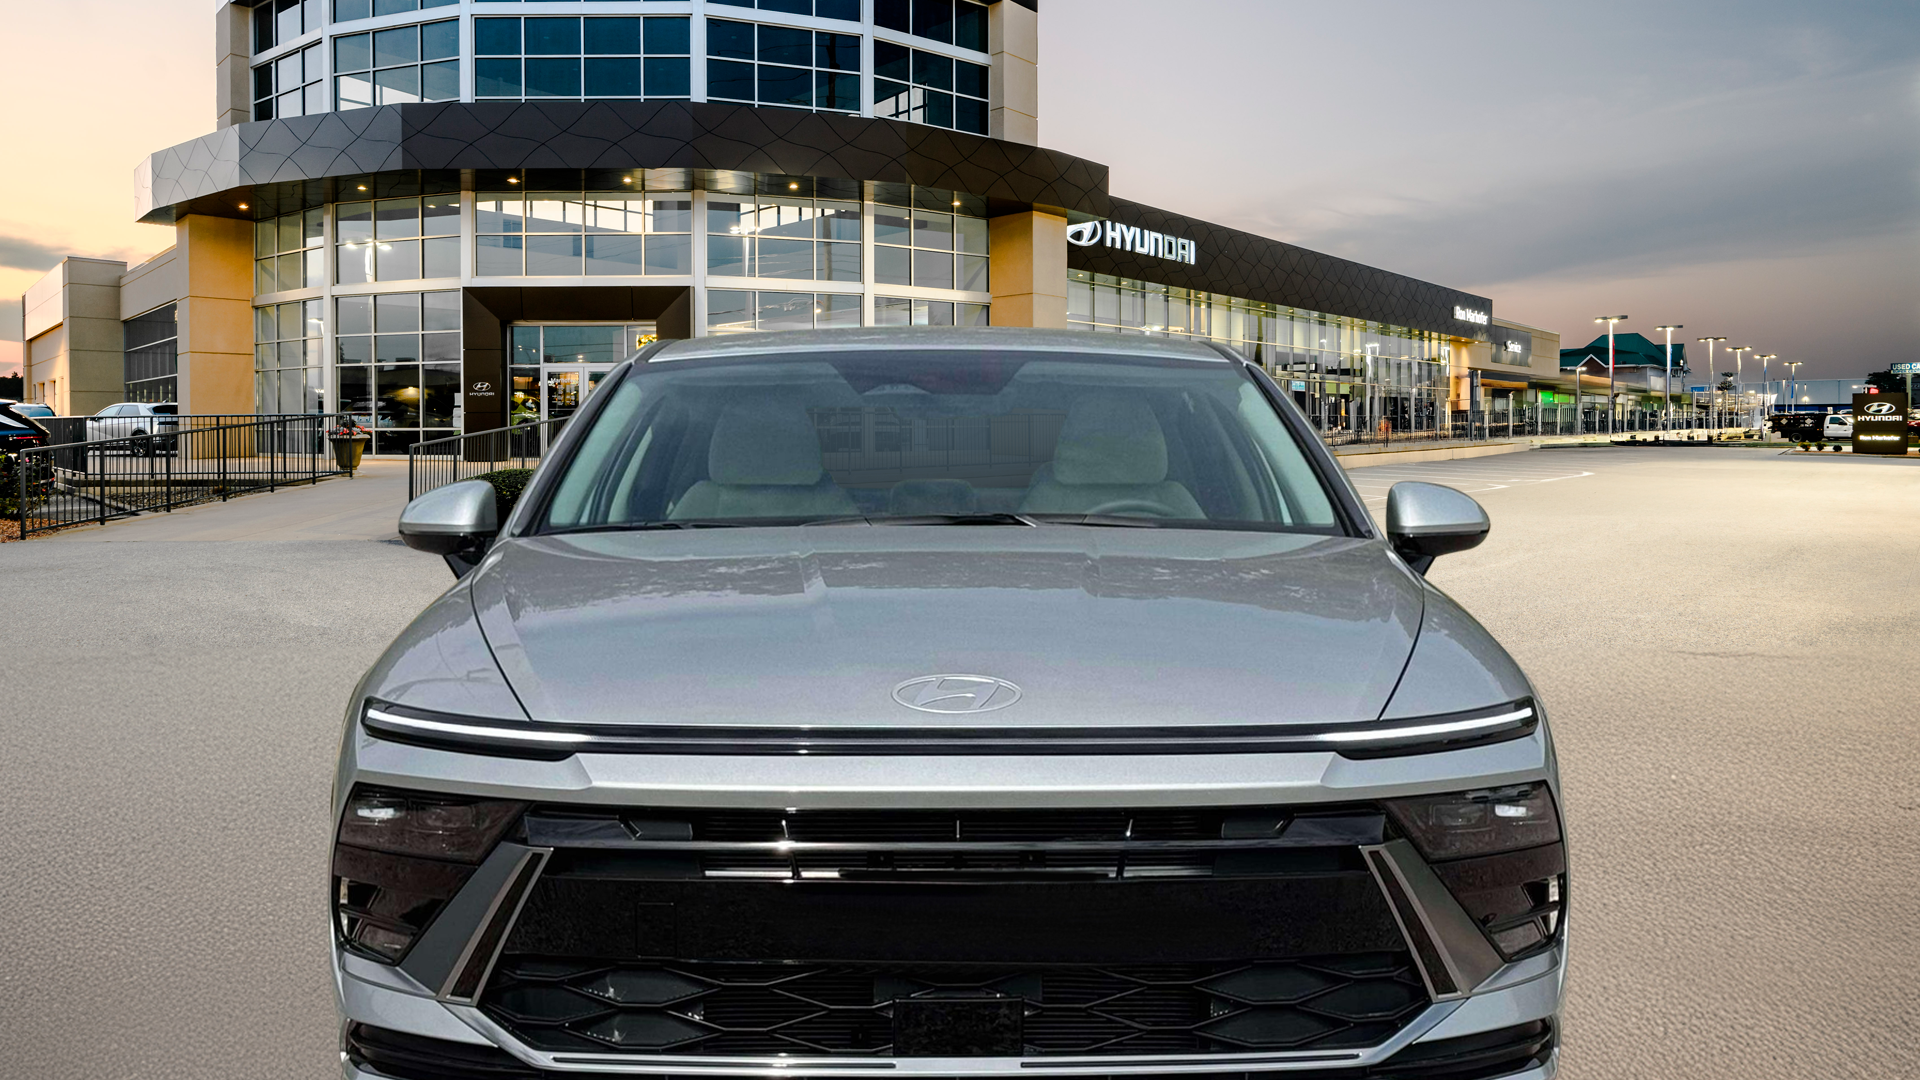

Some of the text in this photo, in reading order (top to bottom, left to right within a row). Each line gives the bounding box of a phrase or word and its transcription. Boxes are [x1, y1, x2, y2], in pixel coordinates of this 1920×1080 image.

[1103, 219, 1196, 265] HYUNDAI
[1454, 305, 1488, 325] Ron Marhofer
[1505, 340, 1521, 353] Service
